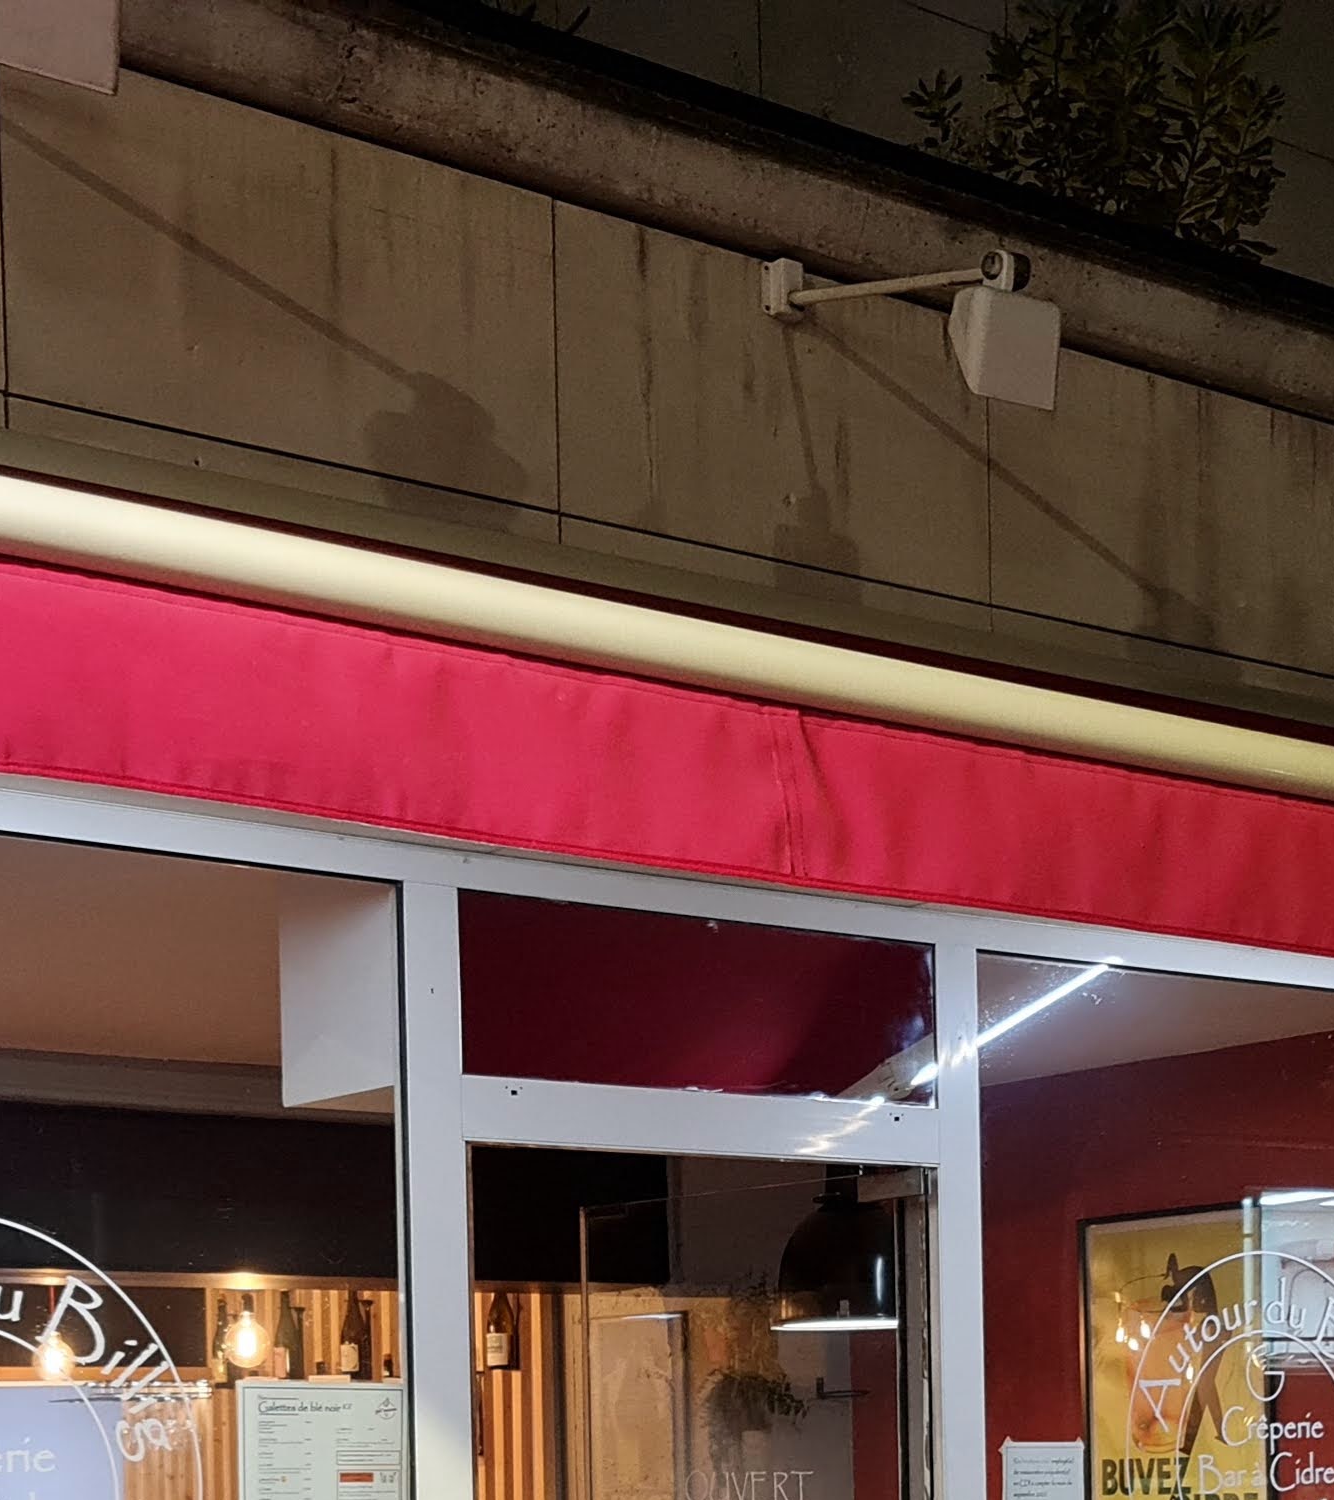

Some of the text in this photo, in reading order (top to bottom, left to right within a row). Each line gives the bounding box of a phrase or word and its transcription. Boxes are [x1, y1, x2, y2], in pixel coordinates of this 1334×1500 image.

[35, 1275, 171, 1463] Billig
[1139, 1299, 1257, 1432] Autour
[1266, 1277, 1306, 1330] du
[1222, 1406, 1324, 1455] Crêperie
[1102, 1457, 1191, 1496] BUVEZ
[1198, 1454, 1247, 1494] Bar
